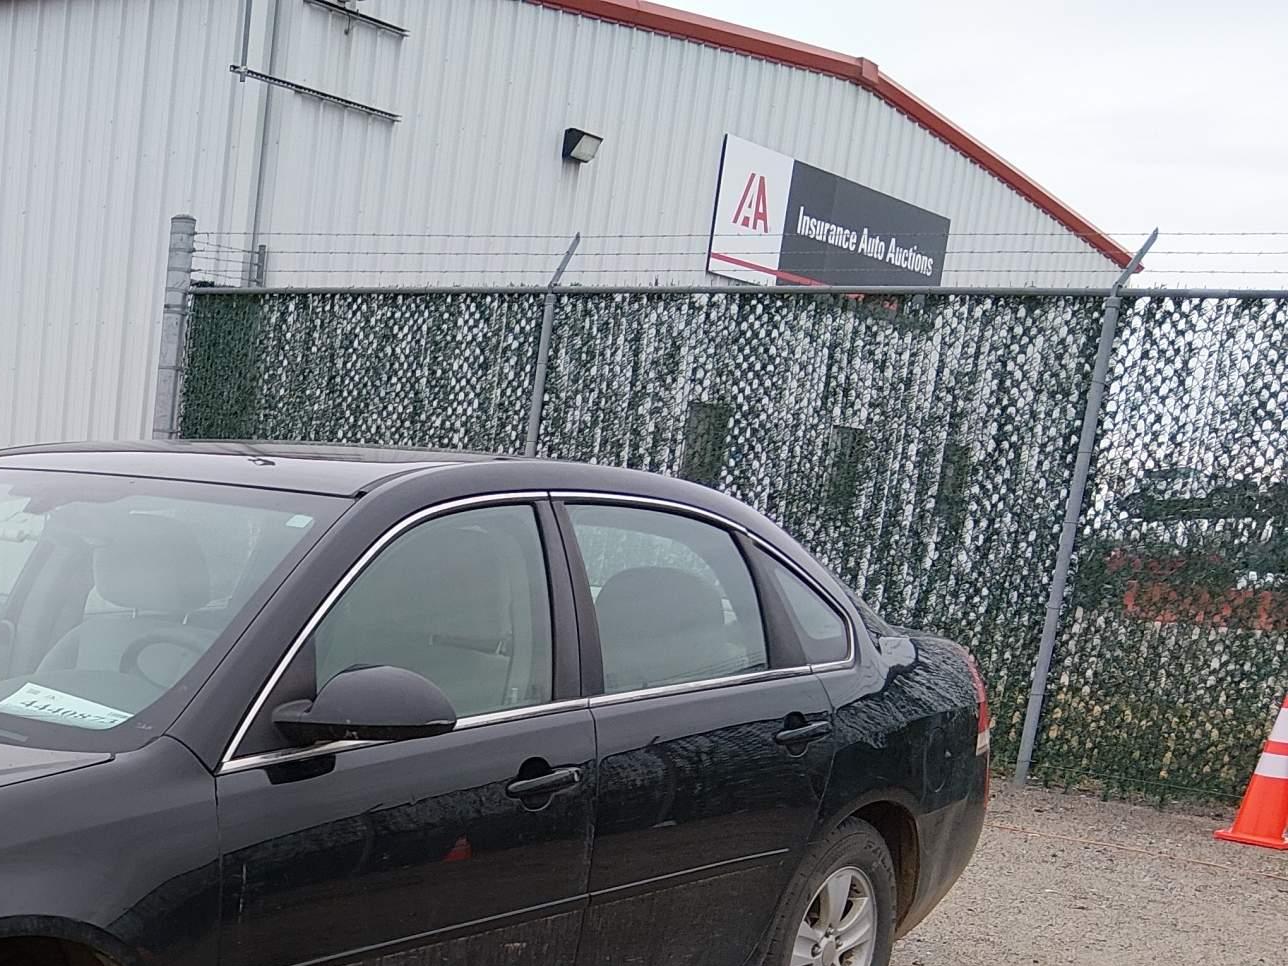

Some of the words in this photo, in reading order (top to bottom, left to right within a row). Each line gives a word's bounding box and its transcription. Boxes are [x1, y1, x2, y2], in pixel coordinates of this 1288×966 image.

[796, 206, 858, 251] Insurance
[858, 227, 886, 261] Auto
[886, 237, 935, 278] Auctions
